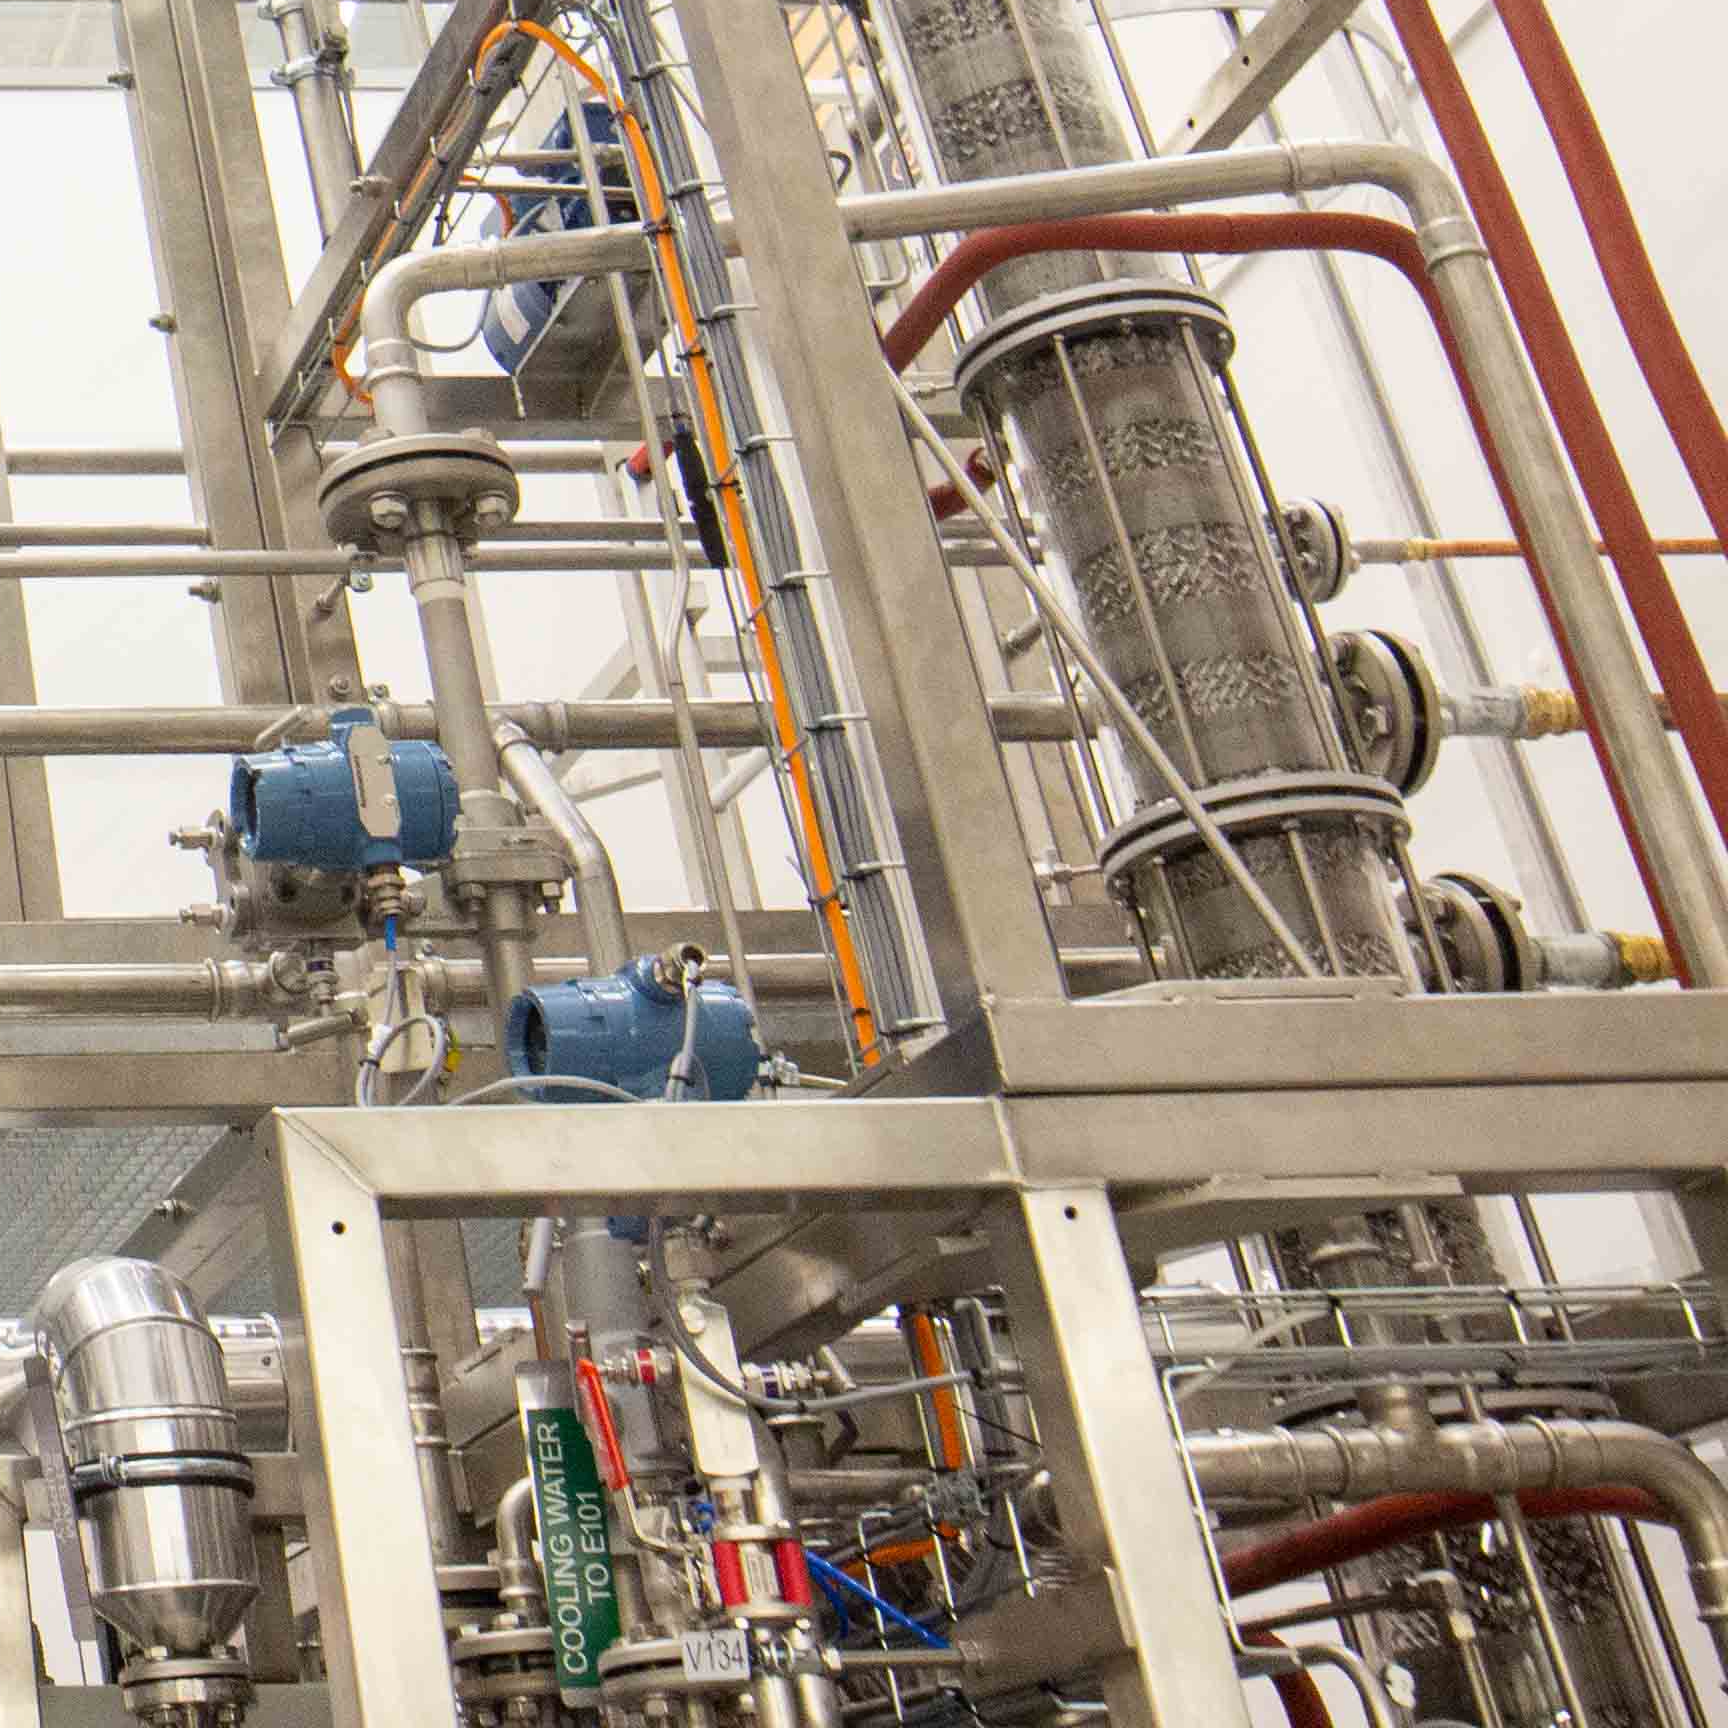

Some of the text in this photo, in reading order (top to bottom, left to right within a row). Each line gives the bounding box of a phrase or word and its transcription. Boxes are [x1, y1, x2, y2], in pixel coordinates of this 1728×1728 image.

[536, 1422, 588, 1674] COOLING WATER
[575, 1491, 611, 1605] TO E101
[685, 1639, 745, 1671] V134
